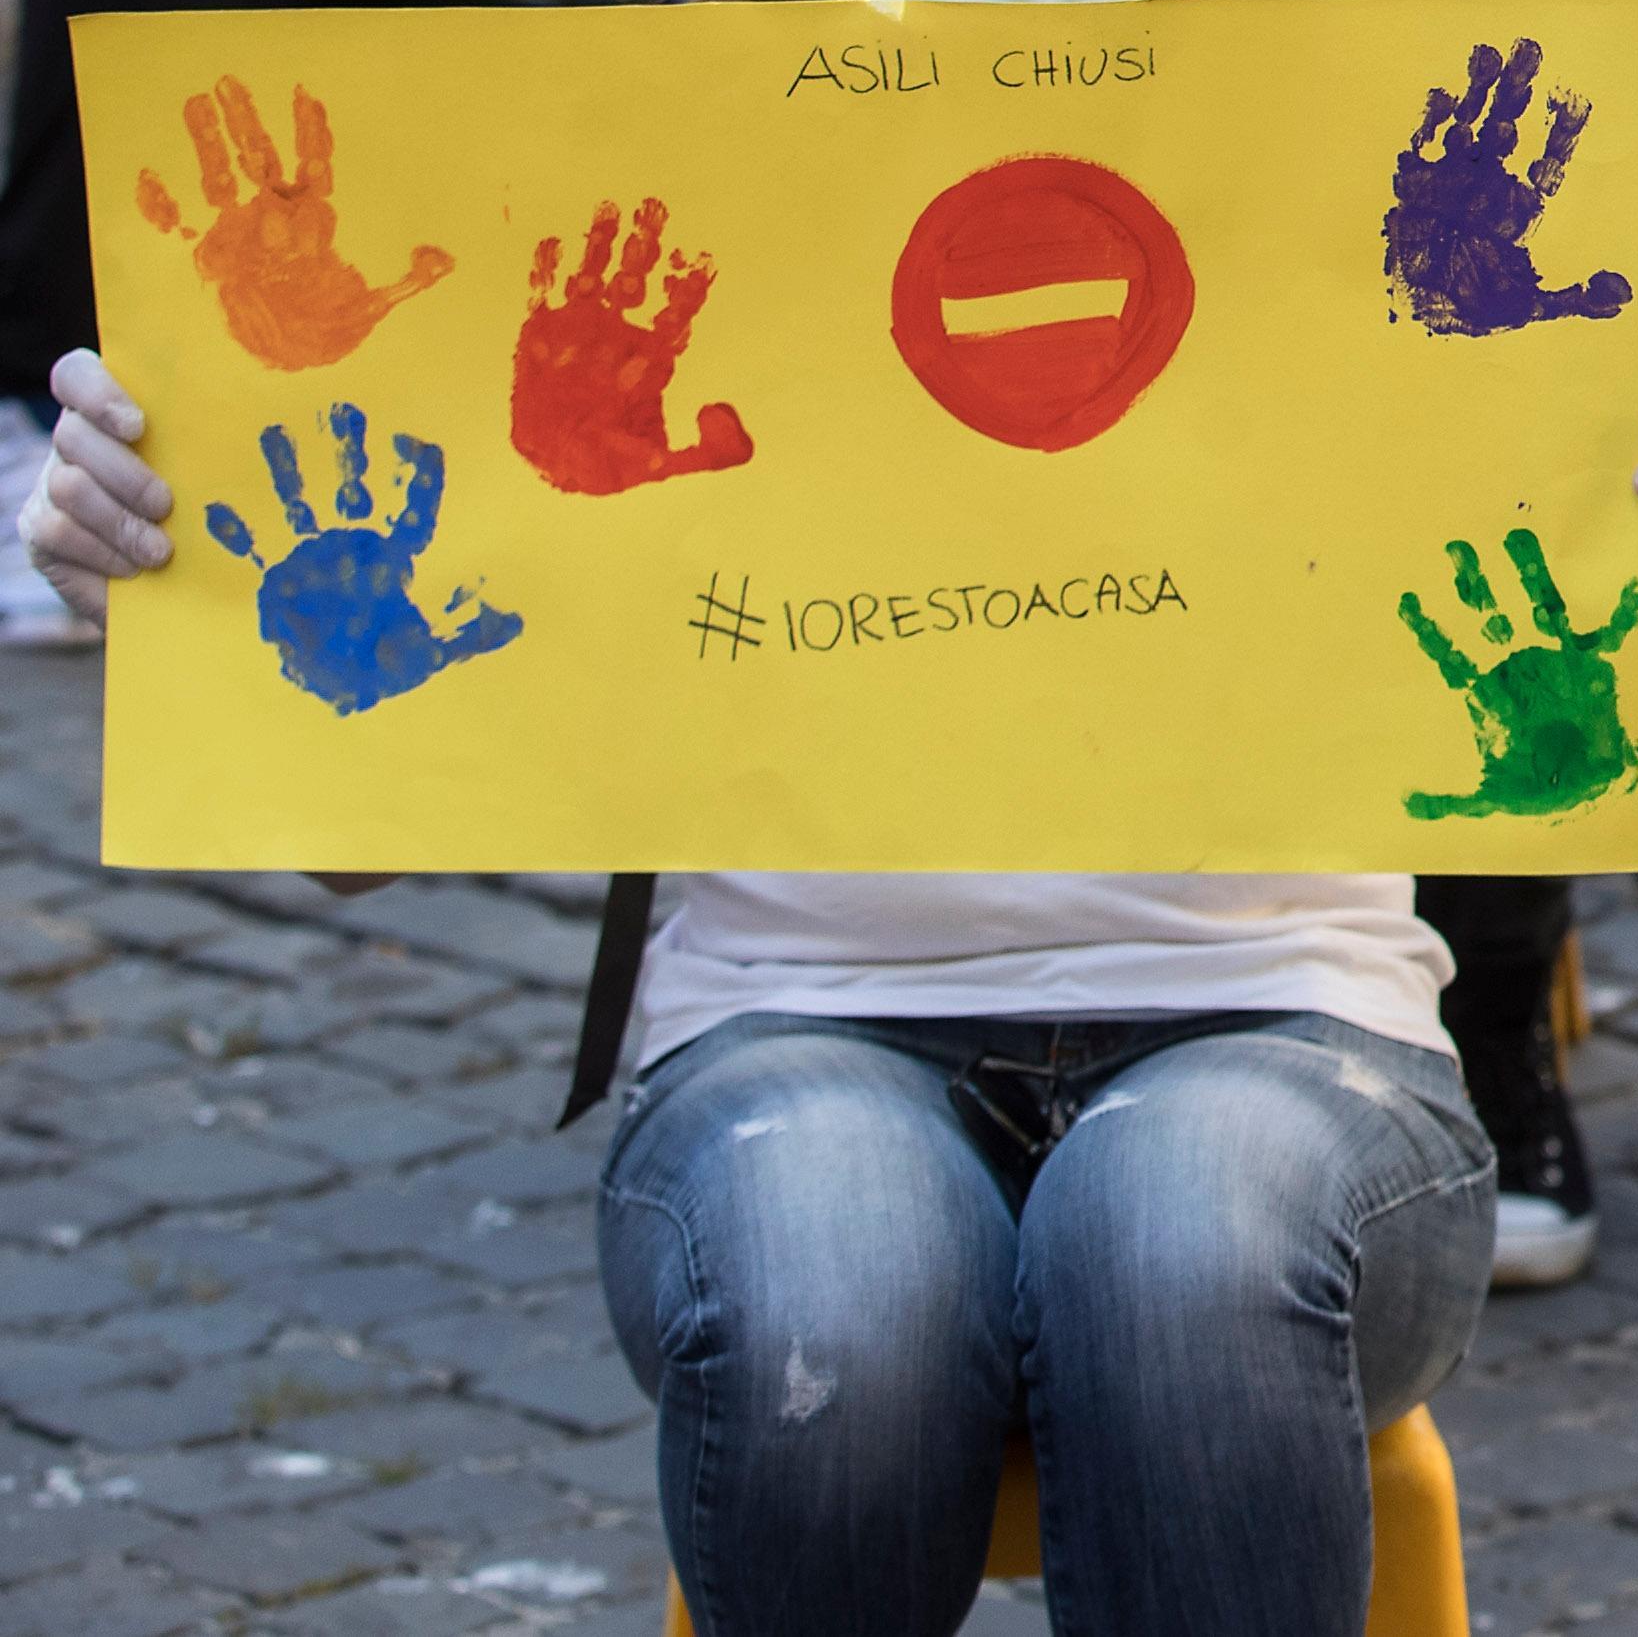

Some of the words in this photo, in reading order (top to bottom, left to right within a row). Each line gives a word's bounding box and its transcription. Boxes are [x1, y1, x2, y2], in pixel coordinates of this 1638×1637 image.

[785, 34, 942, 99] ASILI
[991, 29, 1157, 90] CHIUSI
[686, 566, 1190, 663] #IORESTOACASA
